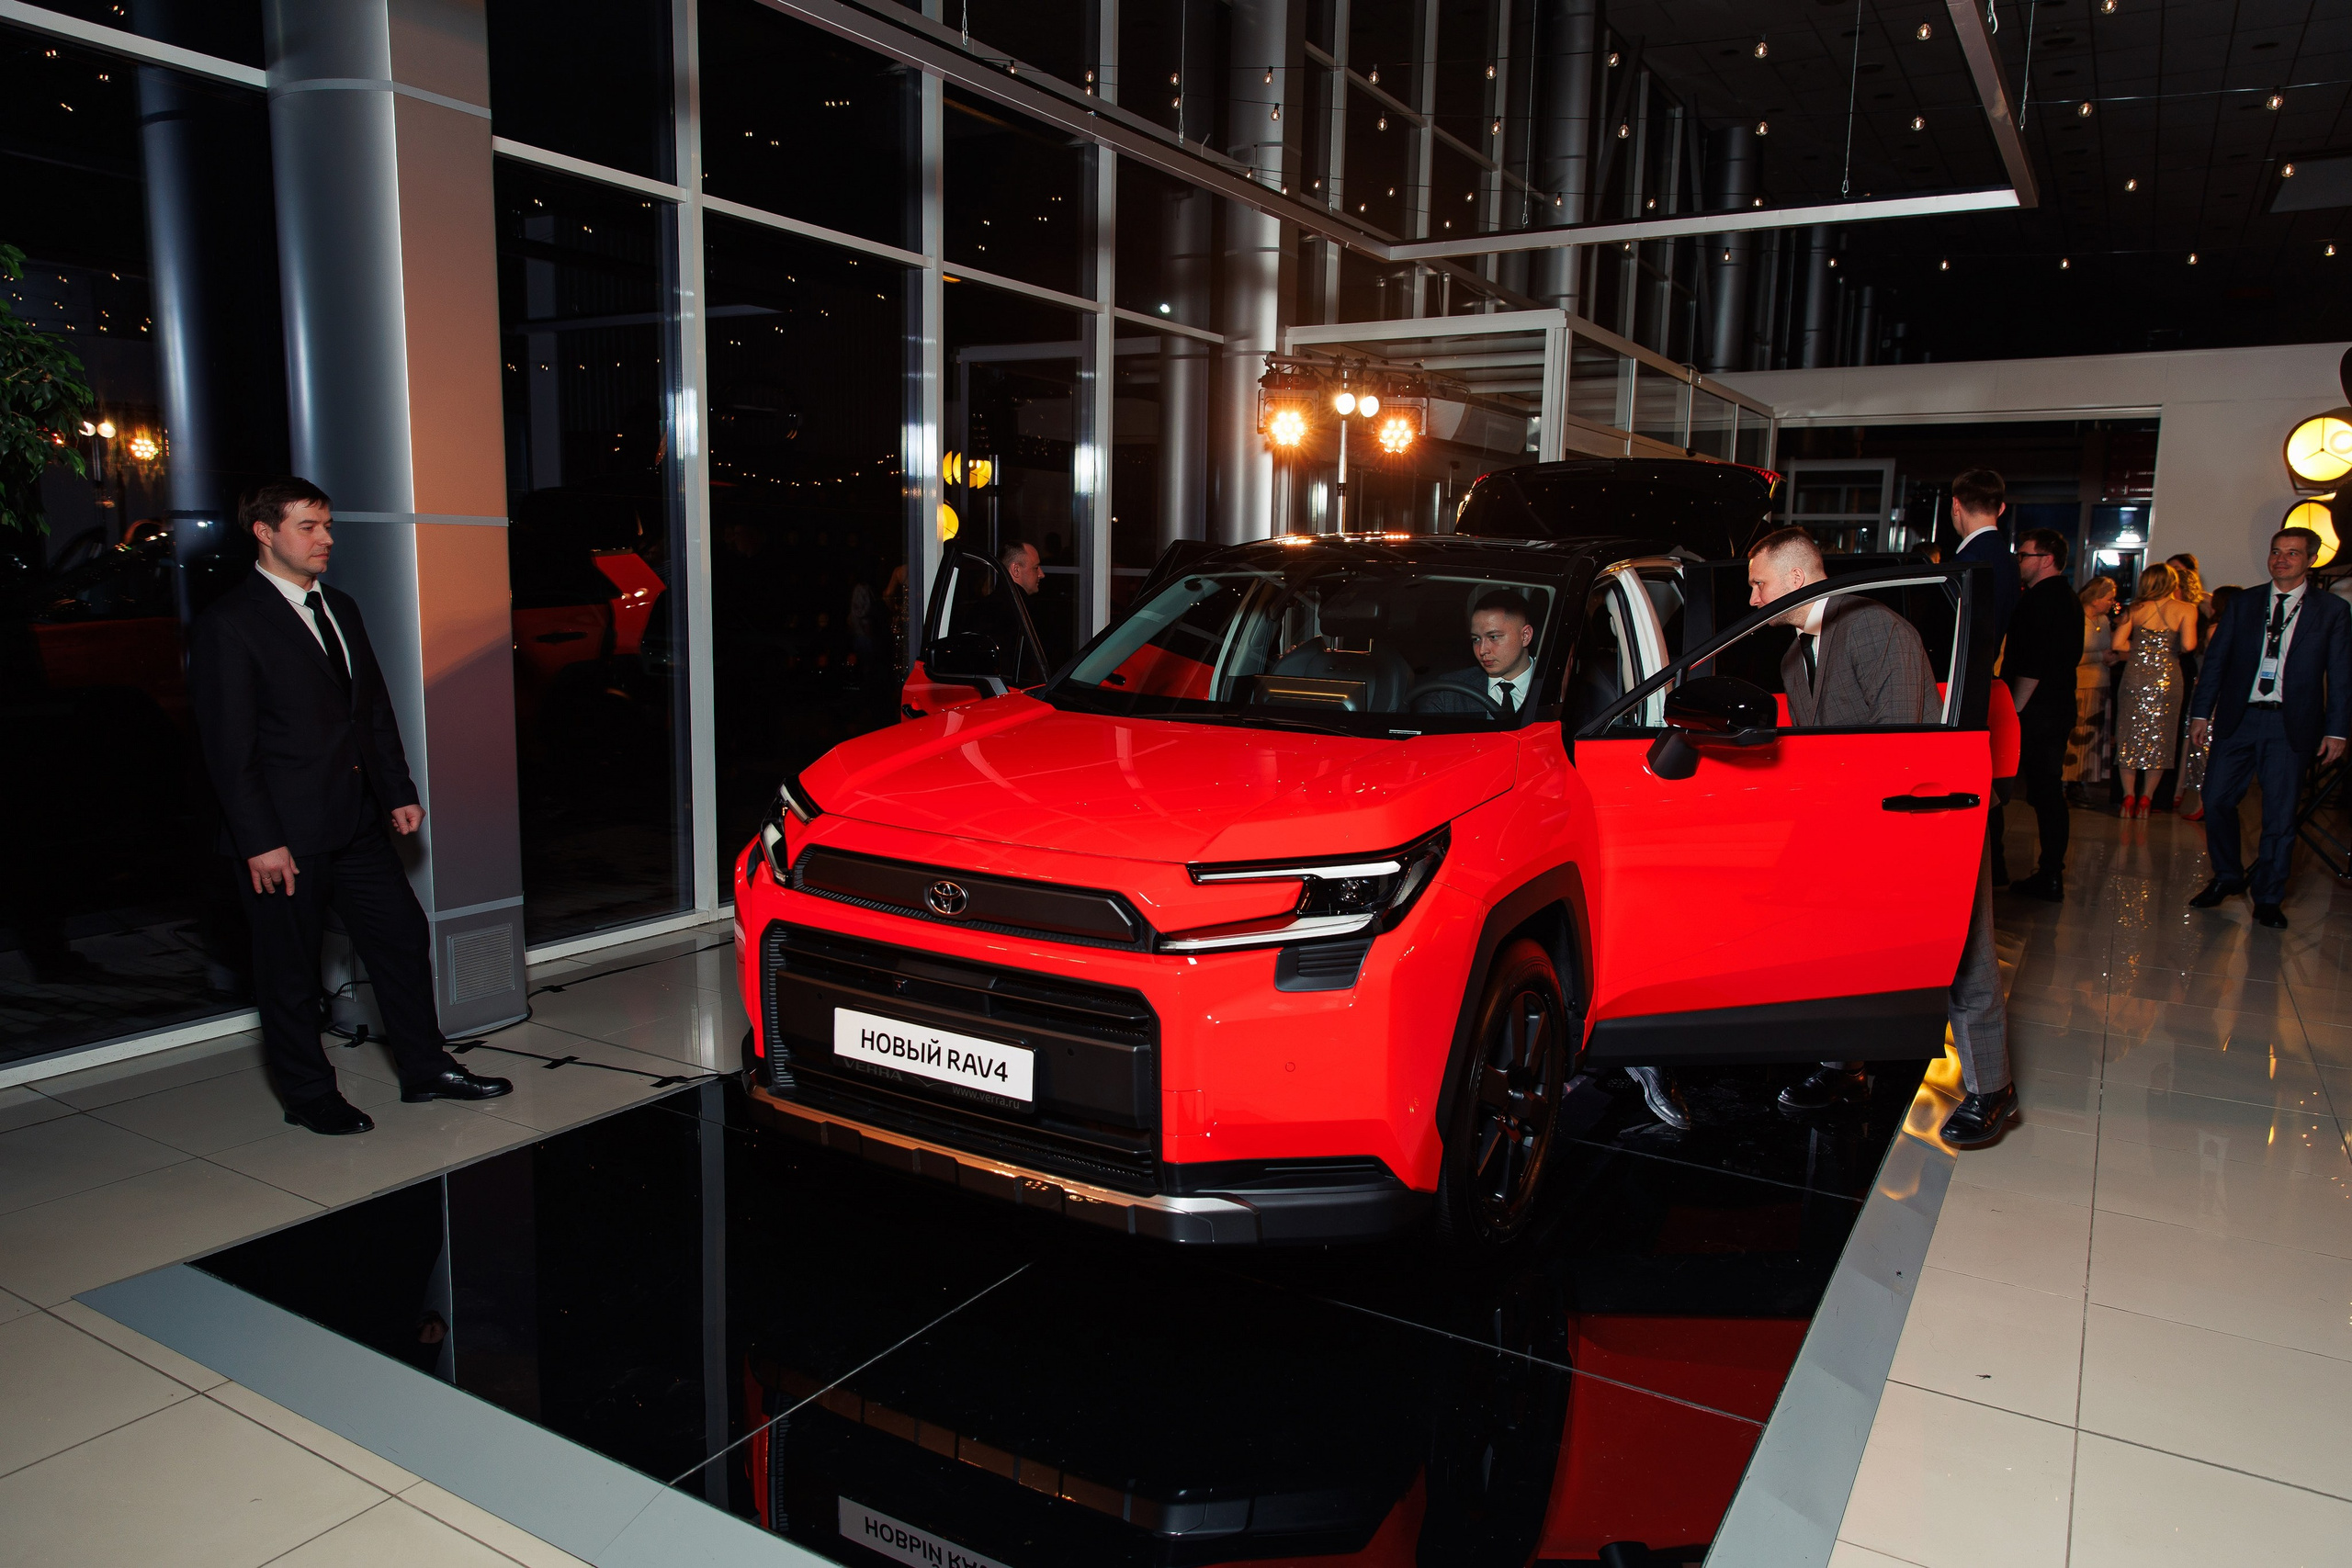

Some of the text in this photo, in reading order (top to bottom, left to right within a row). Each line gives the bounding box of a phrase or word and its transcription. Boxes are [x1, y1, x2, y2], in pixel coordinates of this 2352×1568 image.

[861, 1028, 1008, 1082] НОВЫЙ RAV4
[843, 1057, 903, 1081] VERRA
[952, 1086, 1020, 1110] www.verra.ru
